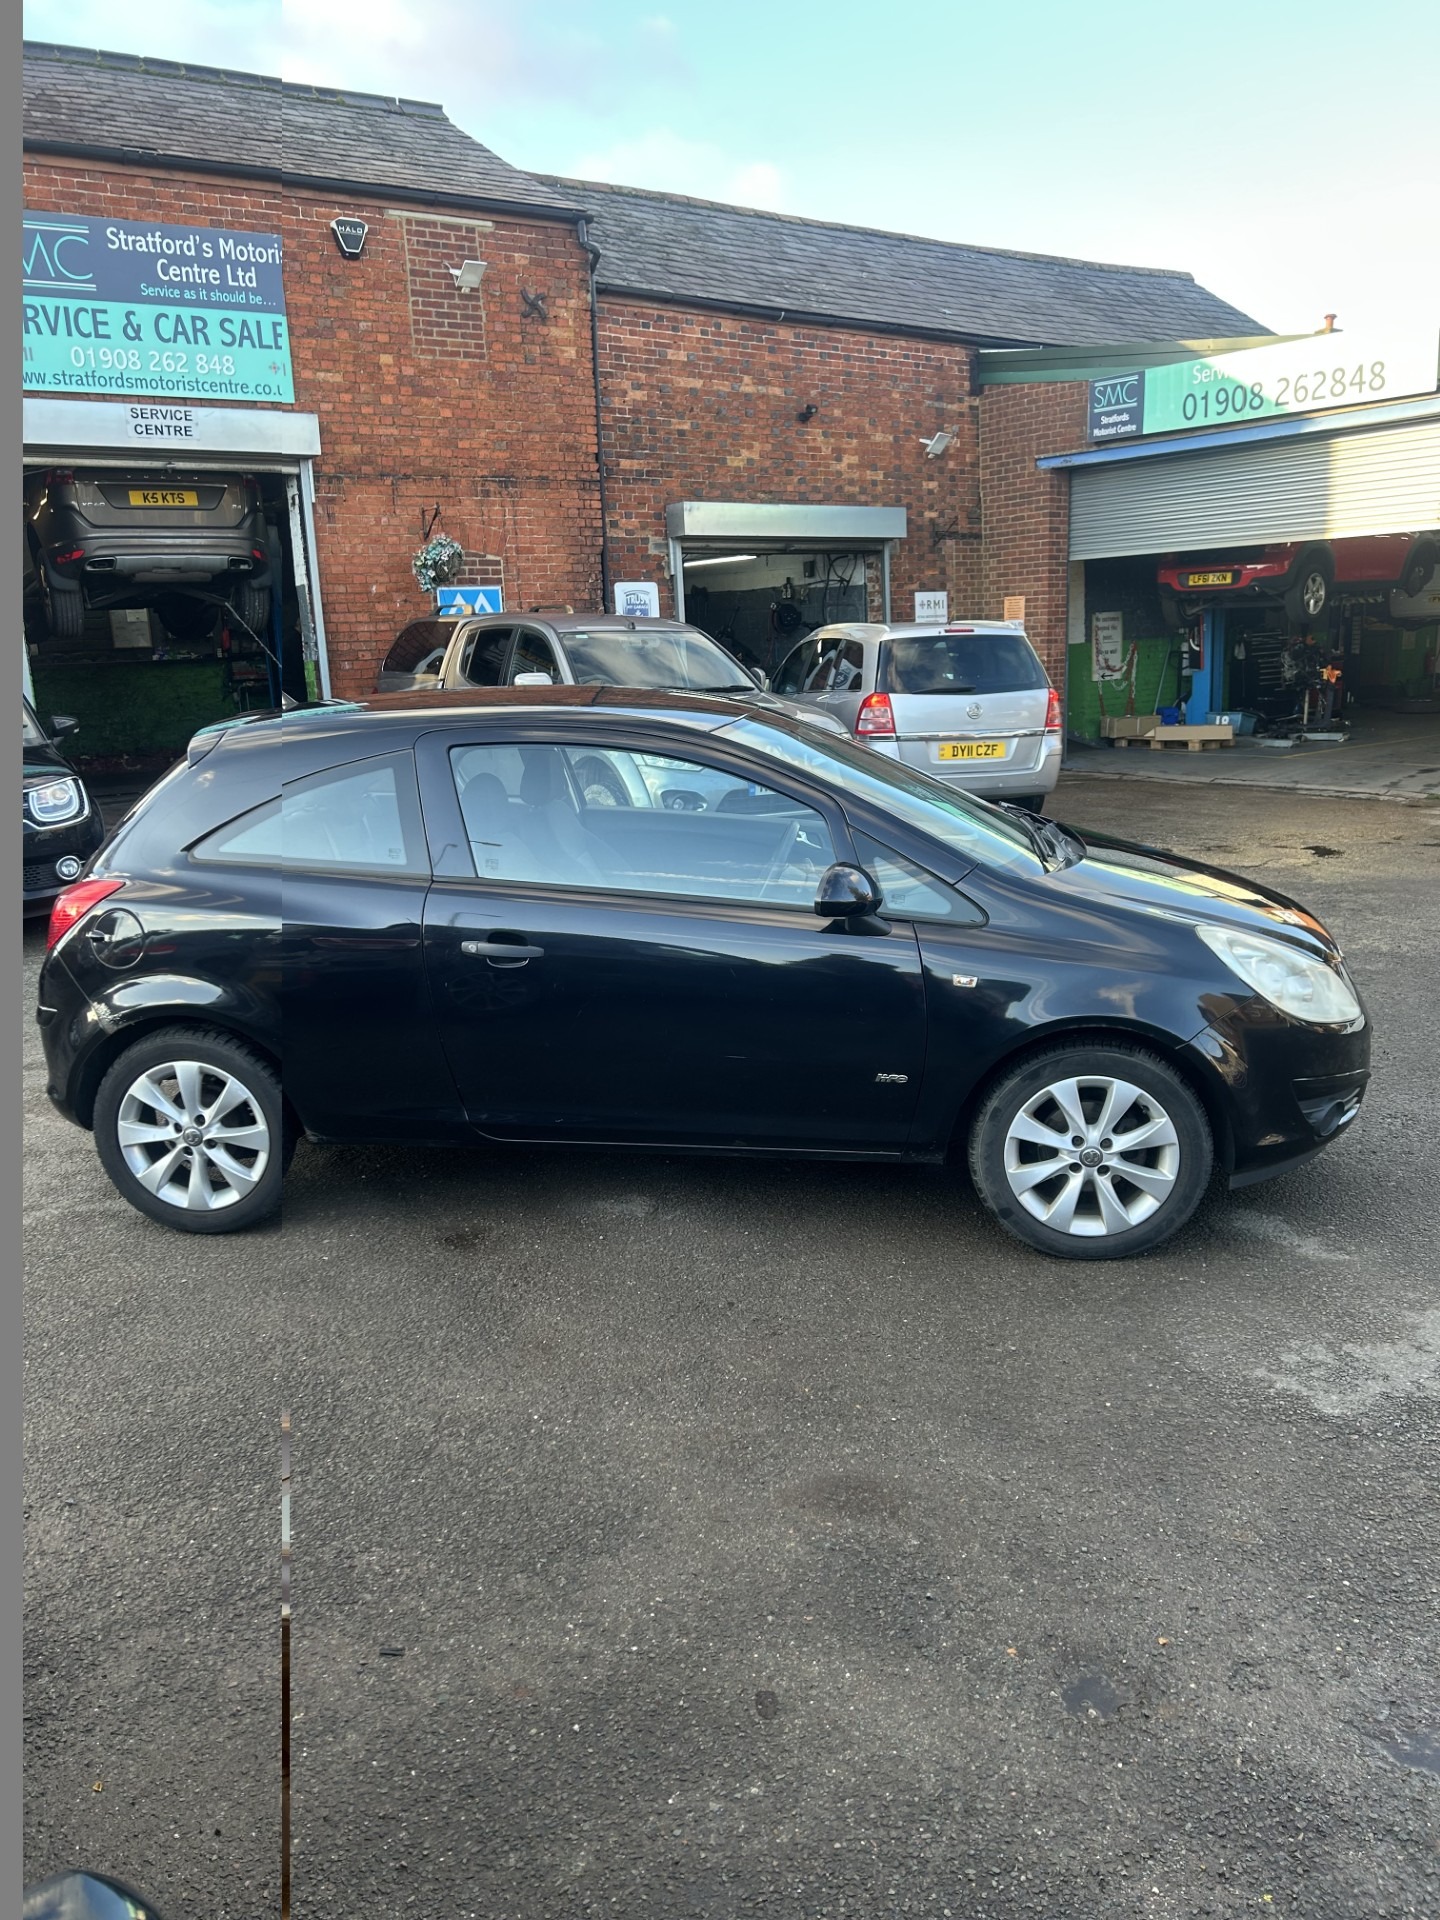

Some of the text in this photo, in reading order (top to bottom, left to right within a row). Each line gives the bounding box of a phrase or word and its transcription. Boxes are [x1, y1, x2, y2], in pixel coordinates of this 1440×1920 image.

[338, 225, 363, 234] HALO
[106, 227, 214, 258] Stratford's
[157, 258, 257, 288] Centre Ltd
[140, 283, 180, 298] Service
[184, 289, 197, 299] as
[199, 287, 208, 300] it
[210, 289, 246, 303] should
[122, 310, 143, 341] &
[154, 312, 211, 346] CAR
[70, 346, 236, 376] 01908 262 848
[1094, 380, 1138, 408] SMC
[1183, 361, 1387, 421] 01908 262848
[130, 407, 194, 421] SERVICE
[1100, 412, 1130, 425] Stratfords
[134, 423, 194, 437] CENTRE
[1093, 424, 1137, 437] Motorist Centre
[162, 492, 185, 504] KTS
[926, 599, 945, 610] RMI
[952, 744, 998, 757] DY11 CZF
